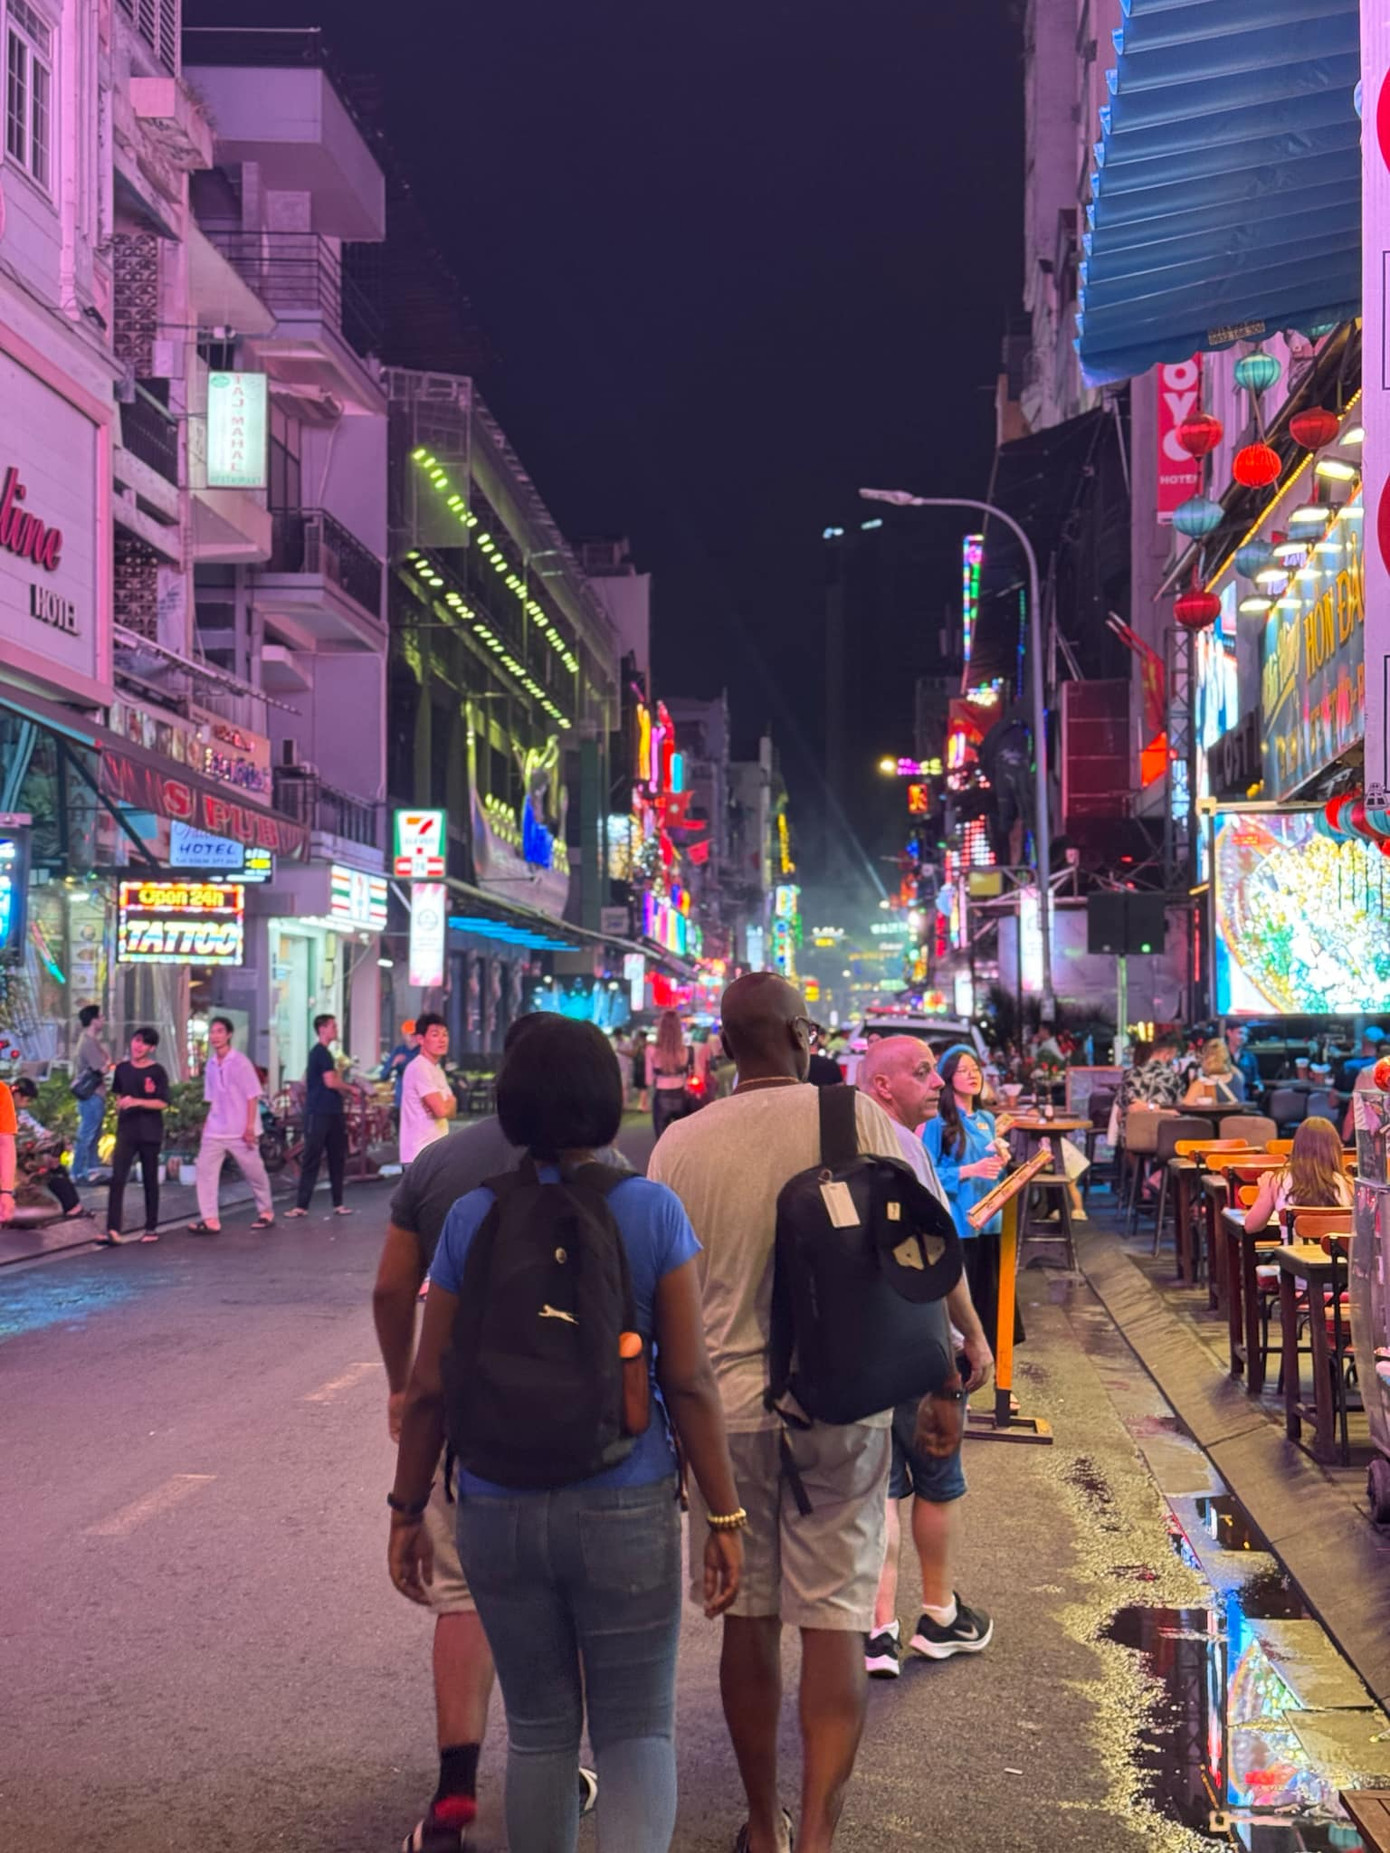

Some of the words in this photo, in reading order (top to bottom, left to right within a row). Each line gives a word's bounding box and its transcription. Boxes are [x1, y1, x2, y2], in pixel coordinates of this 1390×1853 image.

[232, 375, 244, 408] TAJ
[232, 416, 244, 472] MAHAL
[32, 584, 80, 636] HOTEL
[204, 794, 280, 849] PUB
[179, 843, 236, 855] HOTEL
[127, 921, 239, 955] TATTOO
